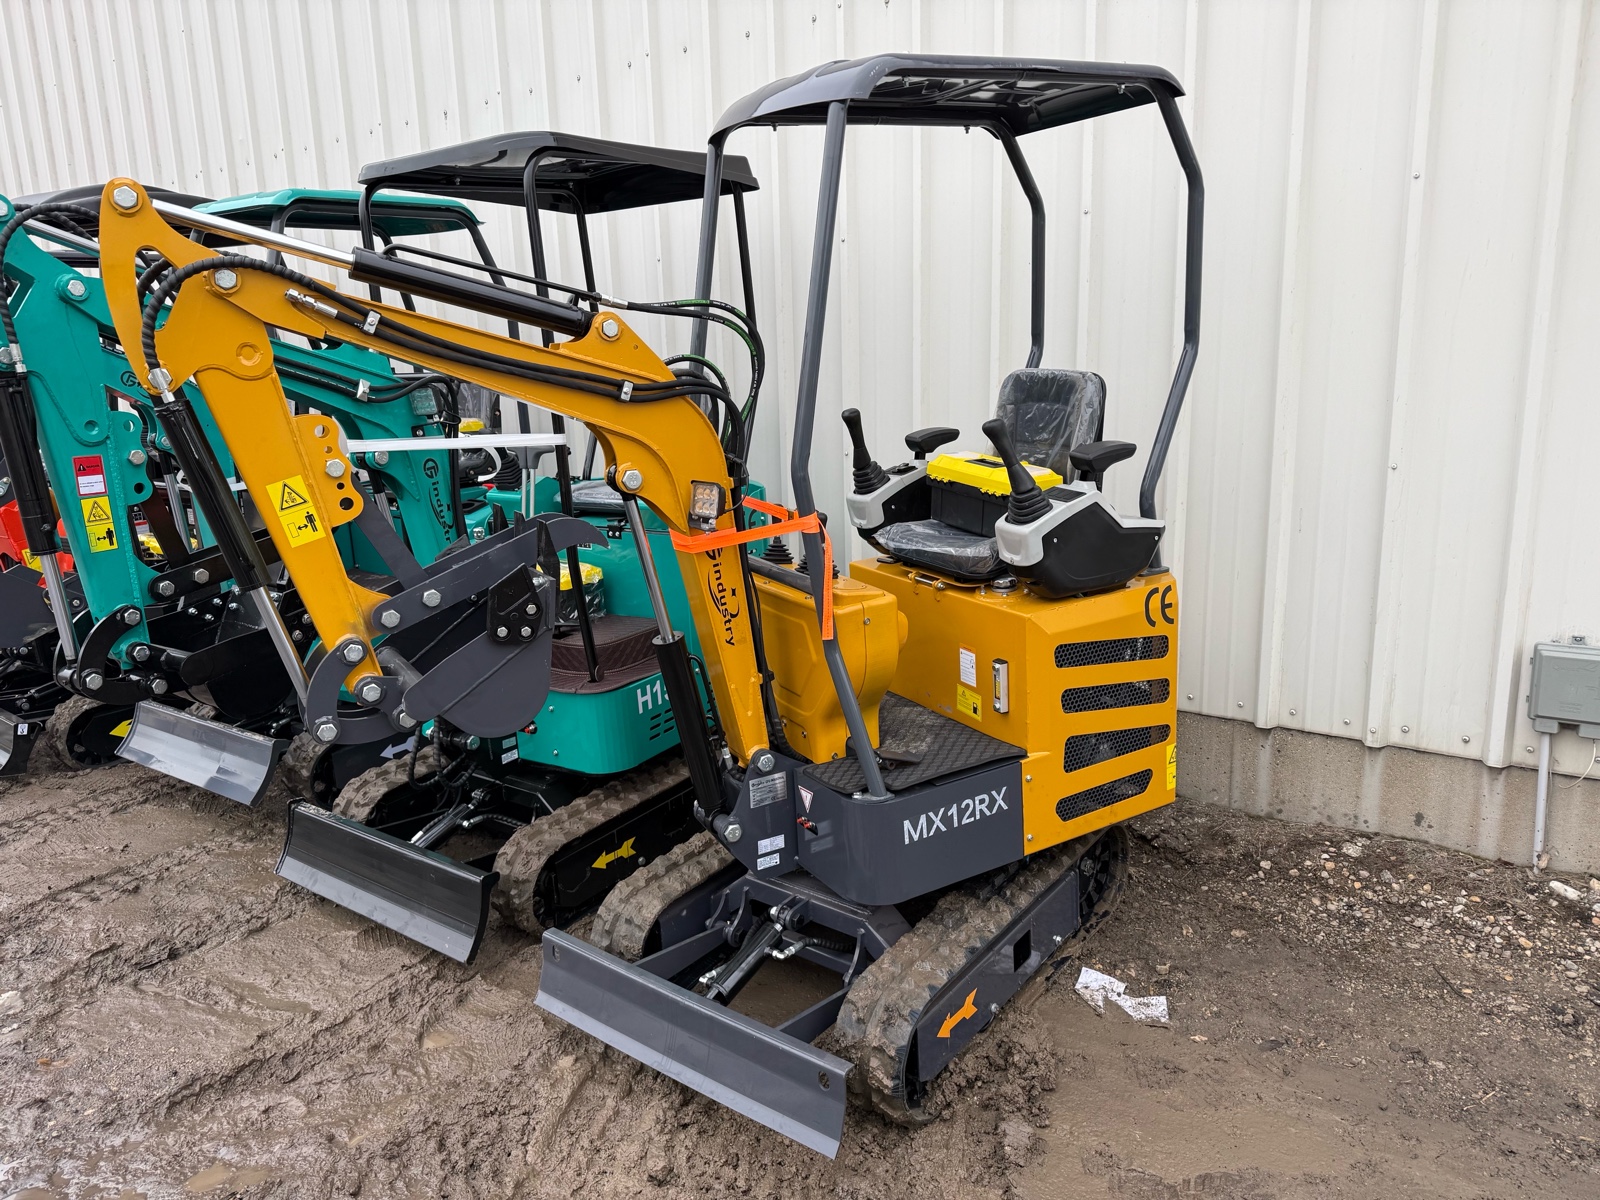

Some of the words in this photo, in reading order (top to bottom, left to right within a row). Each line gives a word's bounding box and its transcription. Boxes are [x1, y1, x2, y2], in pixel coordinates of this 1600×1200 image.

[423, 457, 453, 545] Gindustr
[1144, 584, 1175, 628] CE
[903, 786, 1009, 845] MX12RX
